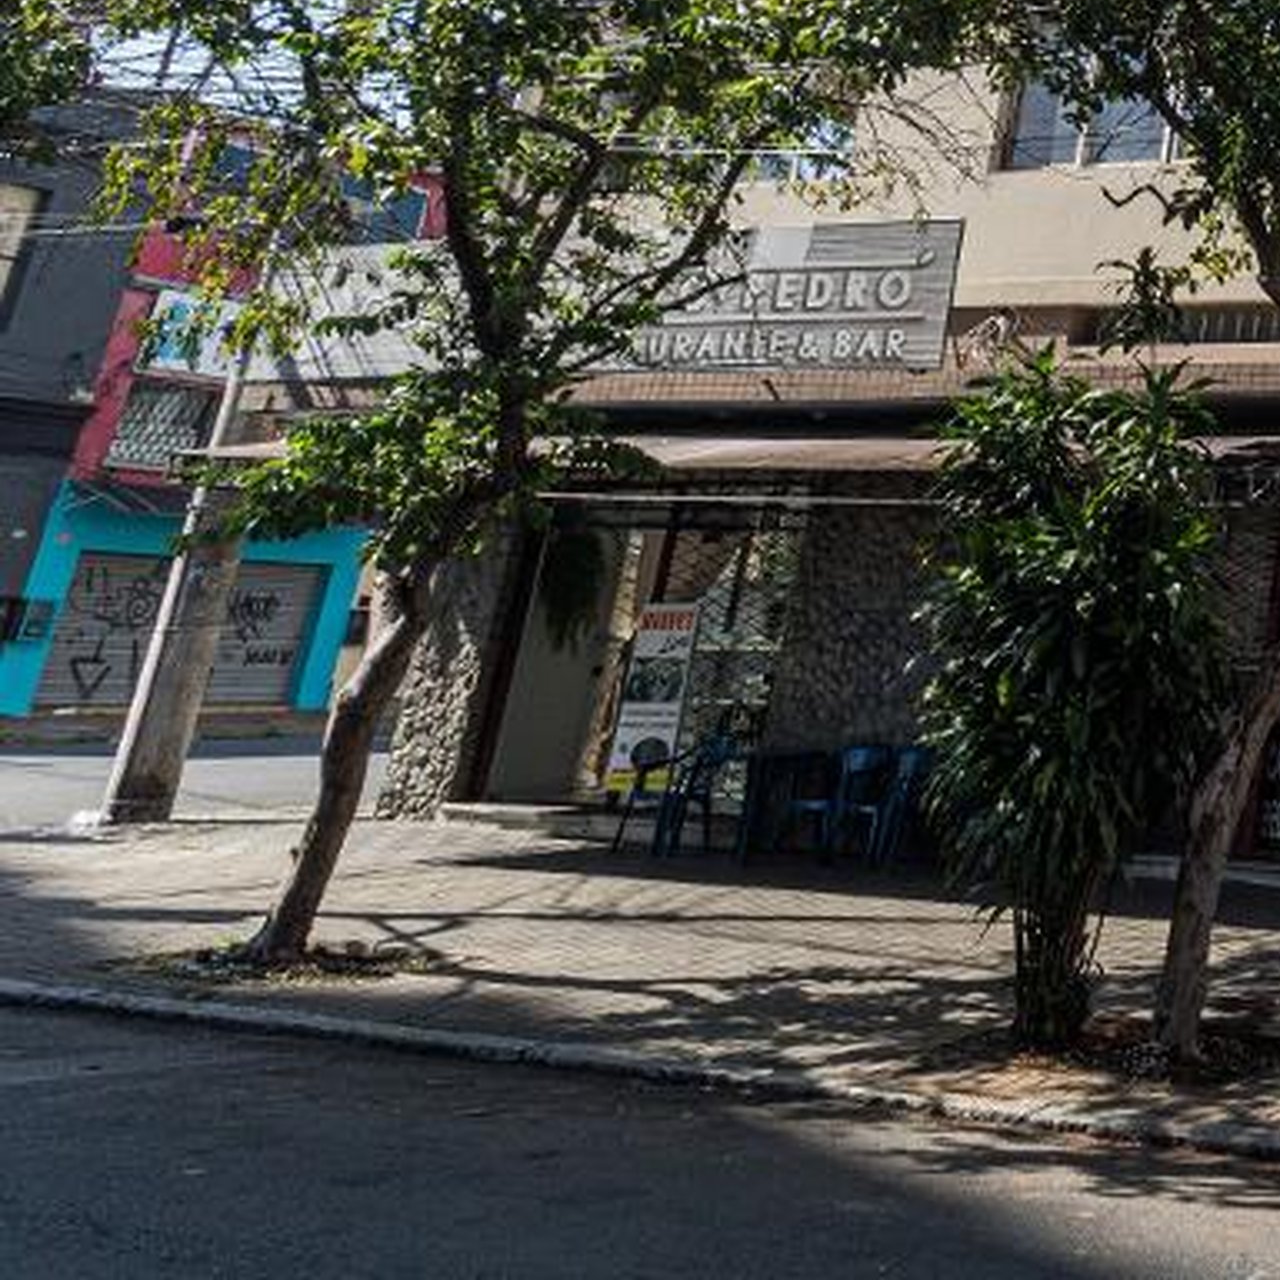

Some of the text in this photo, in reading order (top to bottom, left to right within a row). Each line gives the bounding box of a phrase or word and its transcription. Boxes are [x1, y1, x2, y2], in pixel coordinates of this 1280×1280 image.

[742, 270, 913, 310] PEDRO
[798, 332, 822, 360] &
[832, 328, 908, 360] BAR
